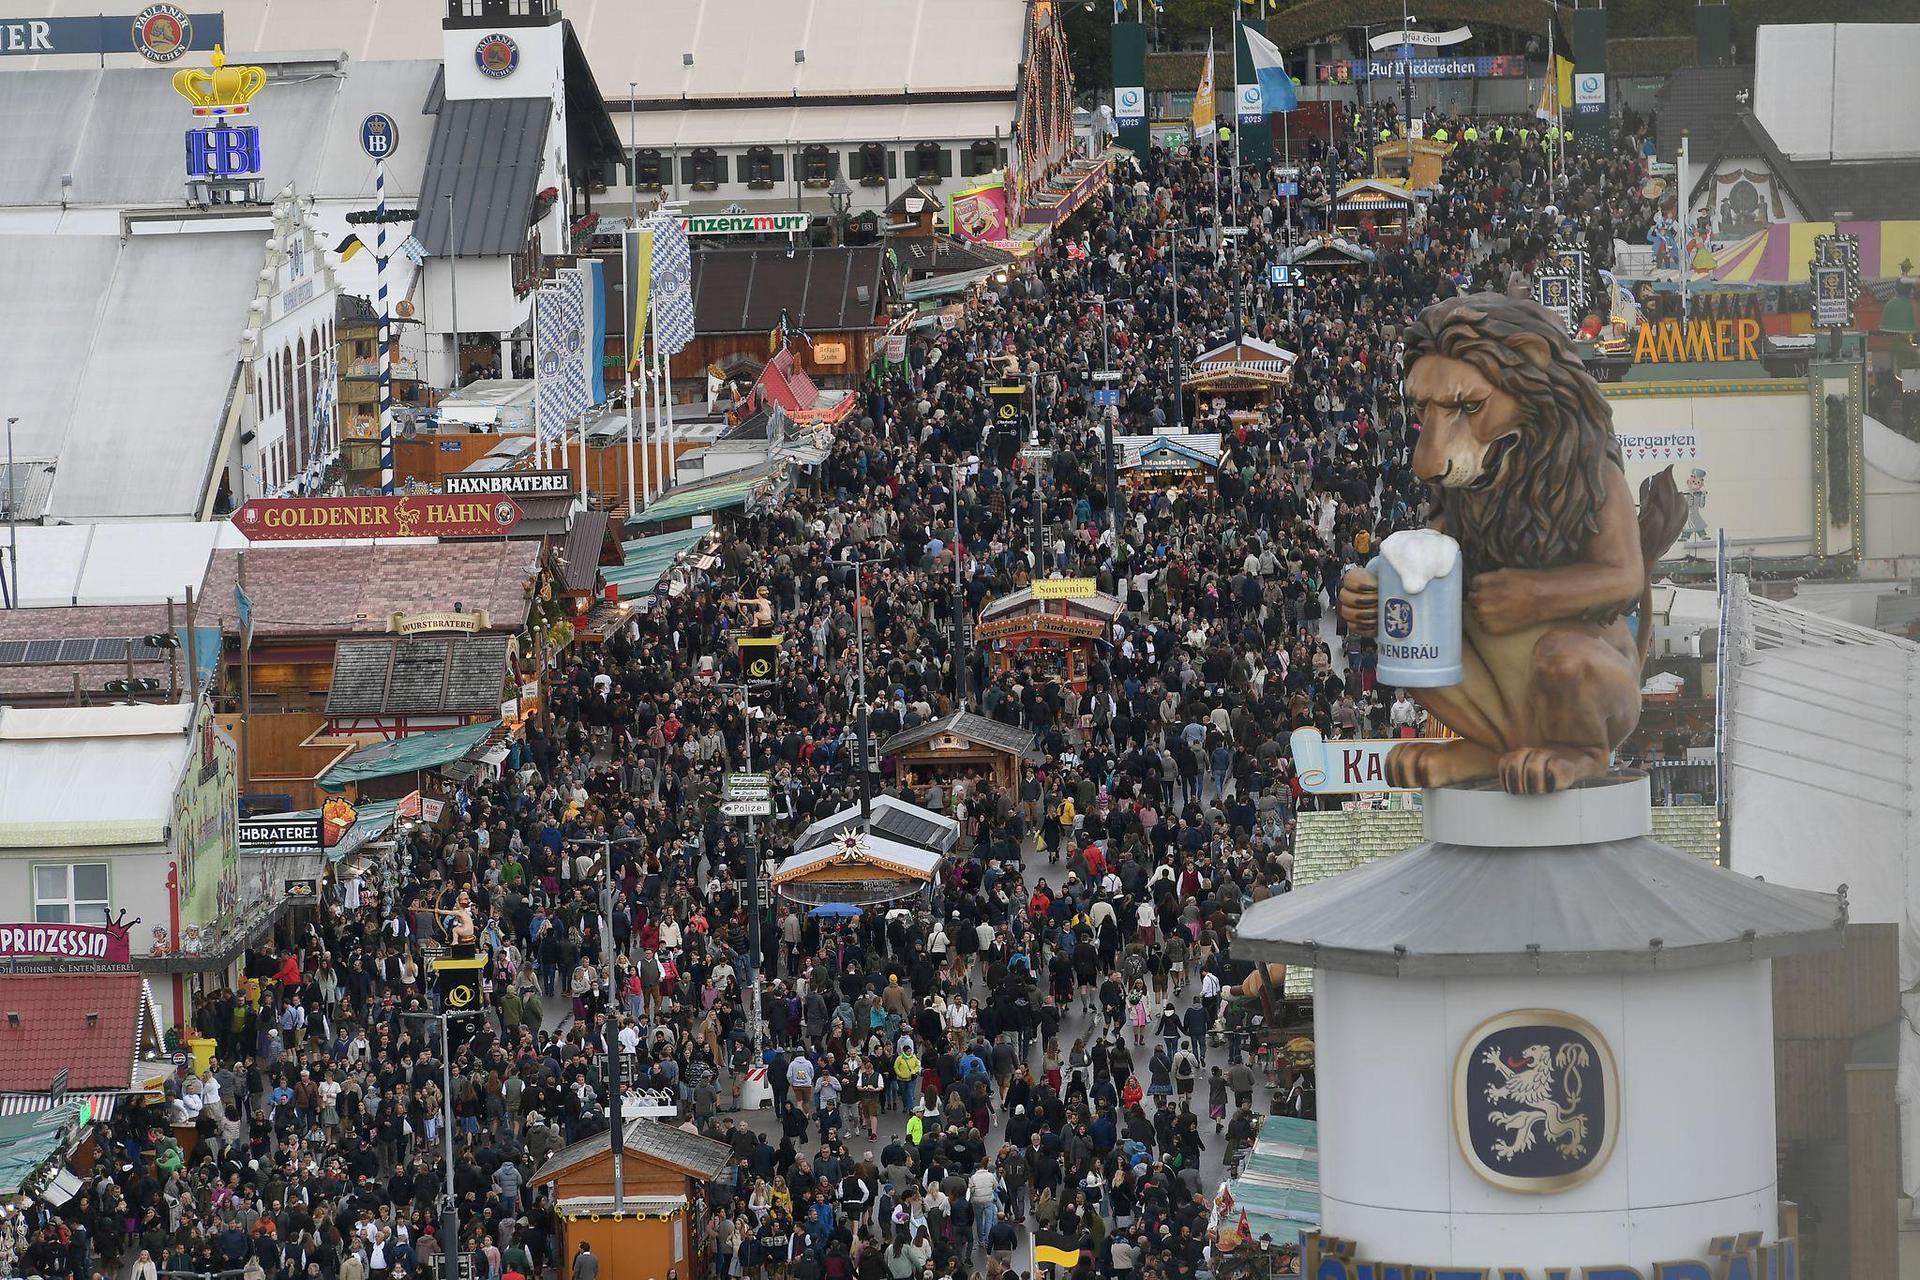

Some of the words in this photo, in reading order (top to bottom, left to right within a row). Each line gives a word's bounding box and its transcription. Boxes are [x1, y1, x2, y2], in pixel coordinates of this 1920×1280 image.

[135, 5, 189, 30] PAULANER
[476, 35, 516, 53] PAULANER
[1369, 62, 1395, 78] Auf
[1395, 61, 1476, 76] Wiedersehen
[1581, 105, 1600, 113] 2025
[1121, 118, 1139, 126] 2025
[1244, 115, 1262, 123] 2025
[186, 127, 261, 176] HB
[368, 135, 388, 152] HB
[1634, 318, 1760, 364] AMMER
[1614, 433, 1696, 450] Biergarten
[1144, 459, 1187, 467] Mandeln
[446, 475, 568, 494] HAXNBRATEREI
[263, 506, 390, 528] GOLDENER
[426, 503, 492, 523] HAHN
[1039, 583, 1089, 593] Souvenirs
[402, 620, 475, 632] WURSTBRATEREI
[980, 624, 1028, 638] Souvenirs
[1044, 621, 1094, 636] Andenken
[1343, 749, 1383, 784] KA
[733, 803, 765, 813] Polizei
